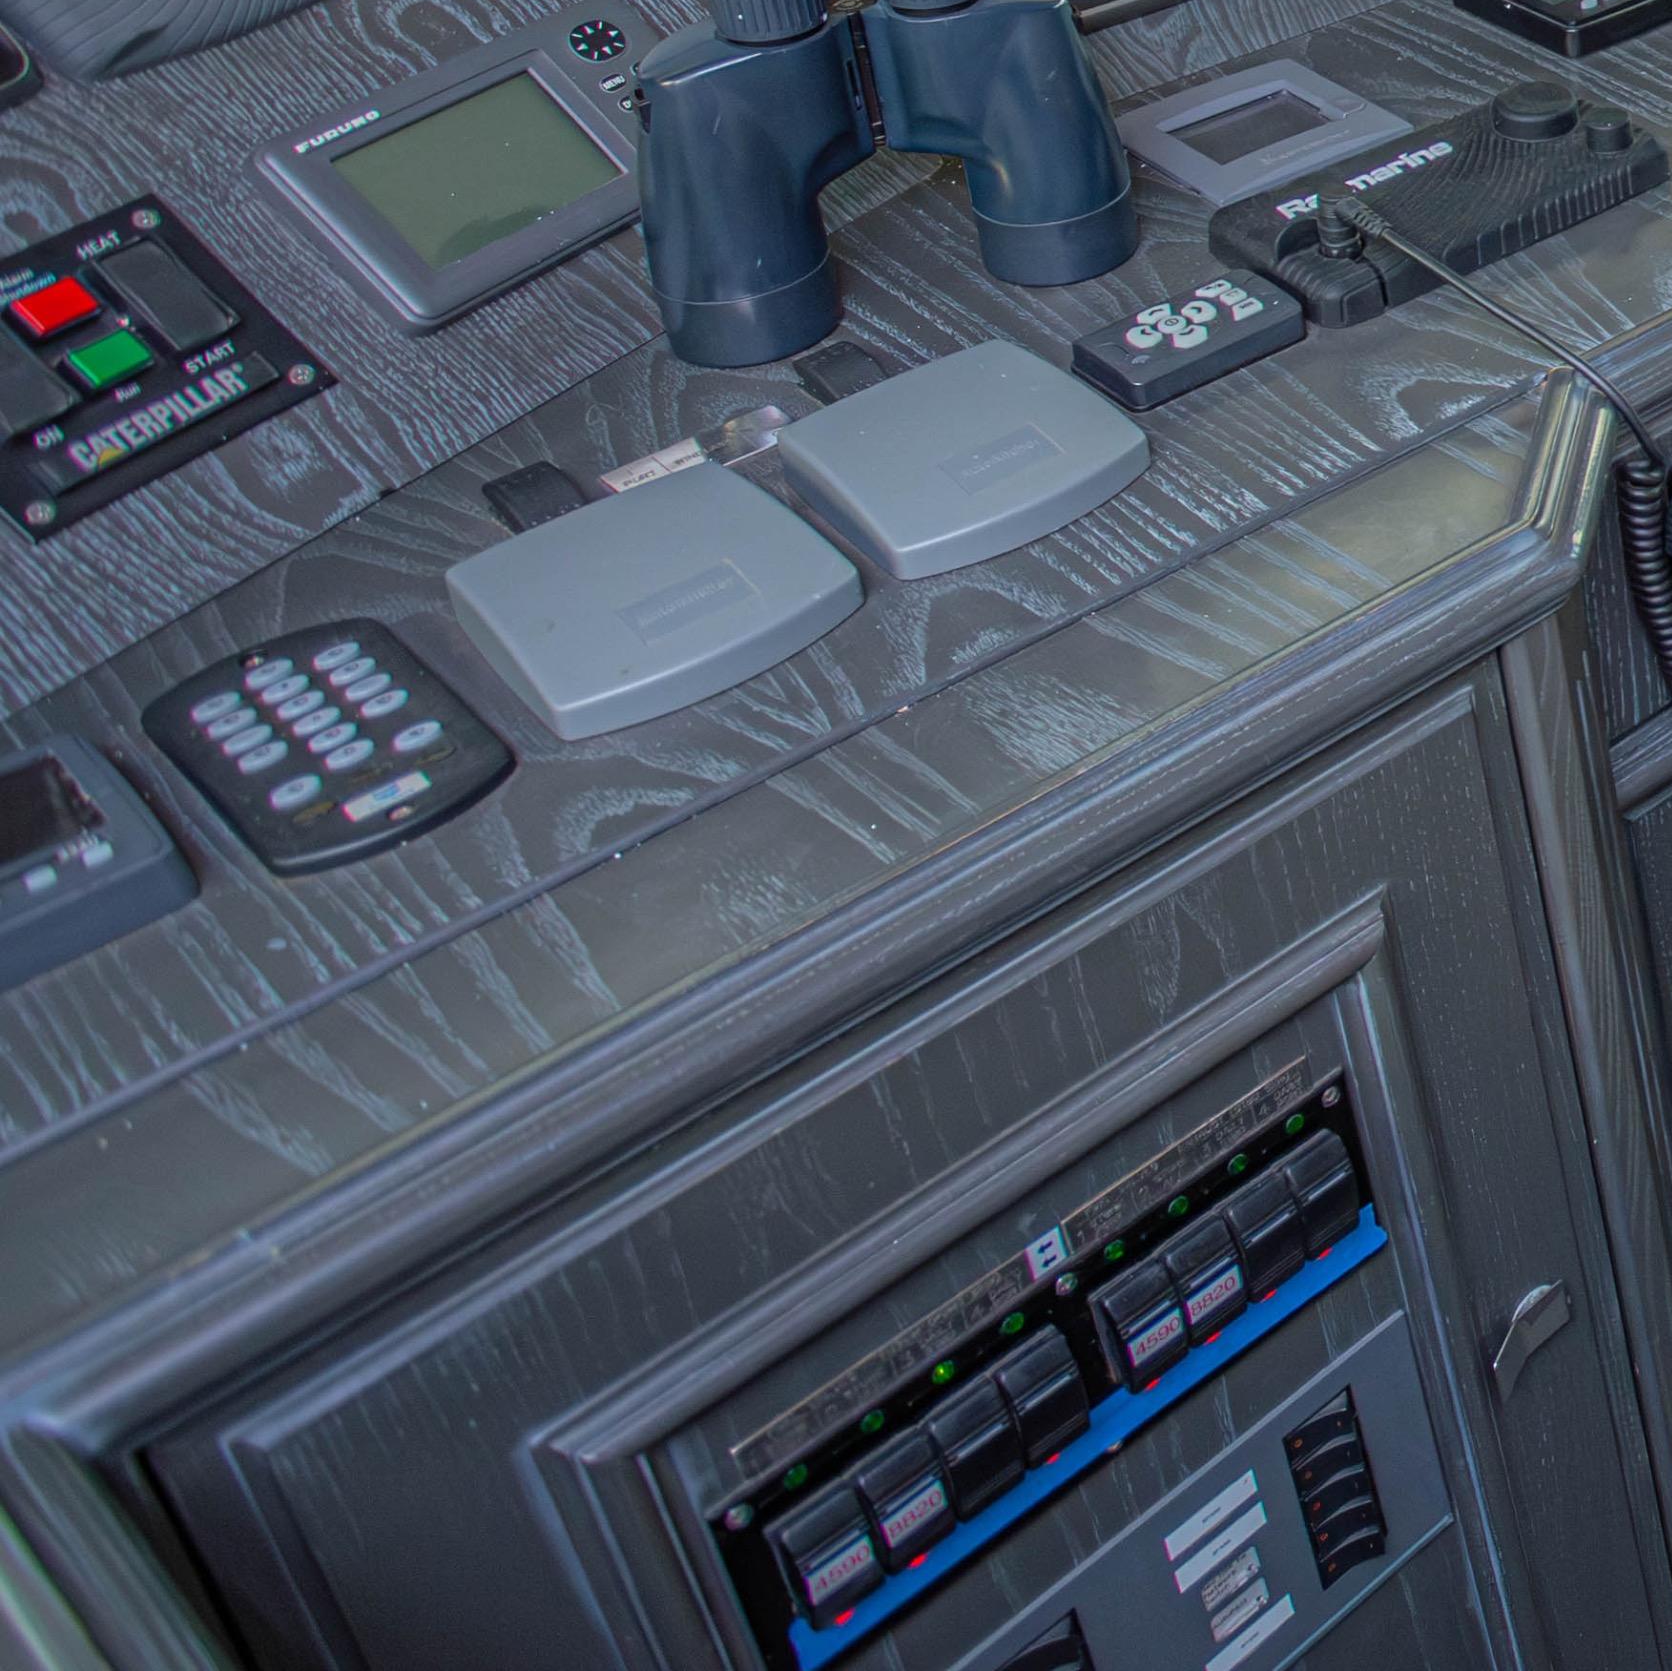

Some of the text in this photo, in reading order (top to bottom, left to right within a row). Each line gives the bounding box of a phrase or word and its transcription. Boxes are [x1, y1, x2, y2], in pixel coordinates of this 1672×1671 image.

[603, 75, 626, 91] MENU
[295, 109, 381, 153] FURUNO
[1275, 140, 1454, 220] Ramarine
[76, 230, 122, 260] HEAT
[182, 339, 236, 375] START
[1189, 1274, 1238, 1316] 8820
[1135, 1316, 1182, 1356] 4590
[887, 1489, 944, 1540] 8820
[813, 1542, 872, 1595] 4590
